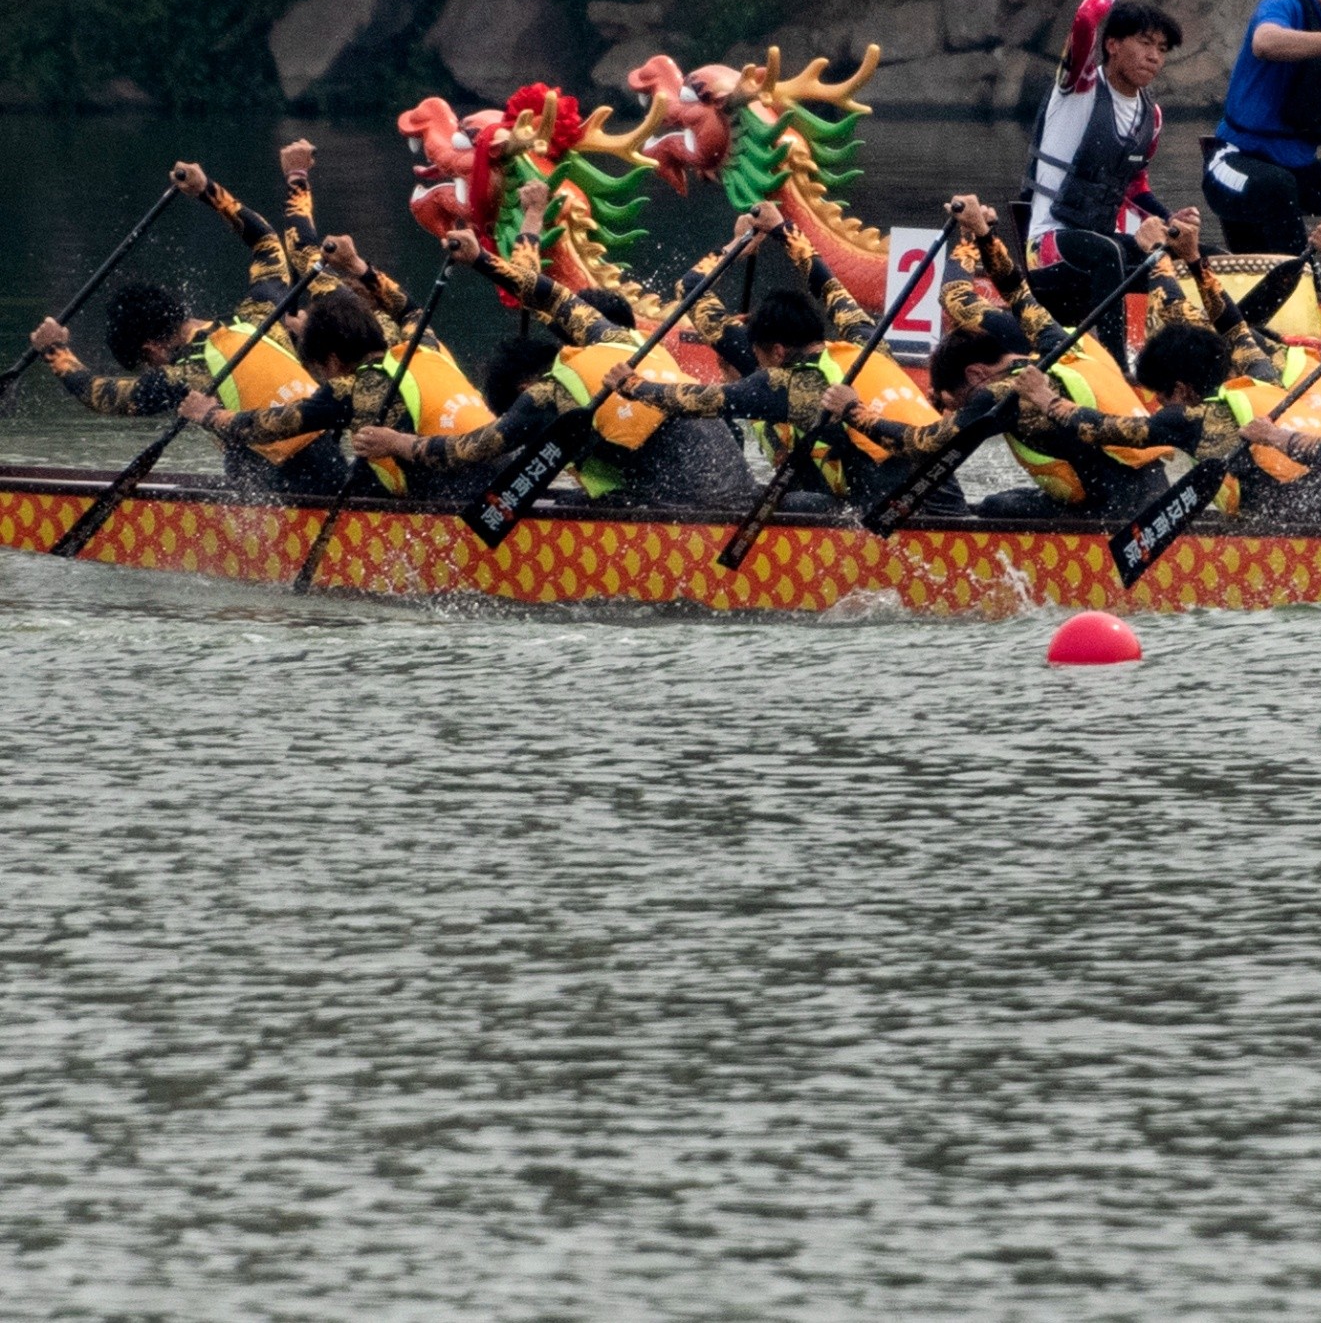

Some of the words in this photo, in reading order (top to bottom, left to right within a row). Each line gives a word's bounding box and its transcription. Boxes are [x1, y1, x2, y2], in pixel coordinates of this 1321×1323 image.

[892, 248, 935, 333] 2
[480, 441, 562, 531] 武汉商学院
[1123, 485, 1198, 568] 武汉商学院
